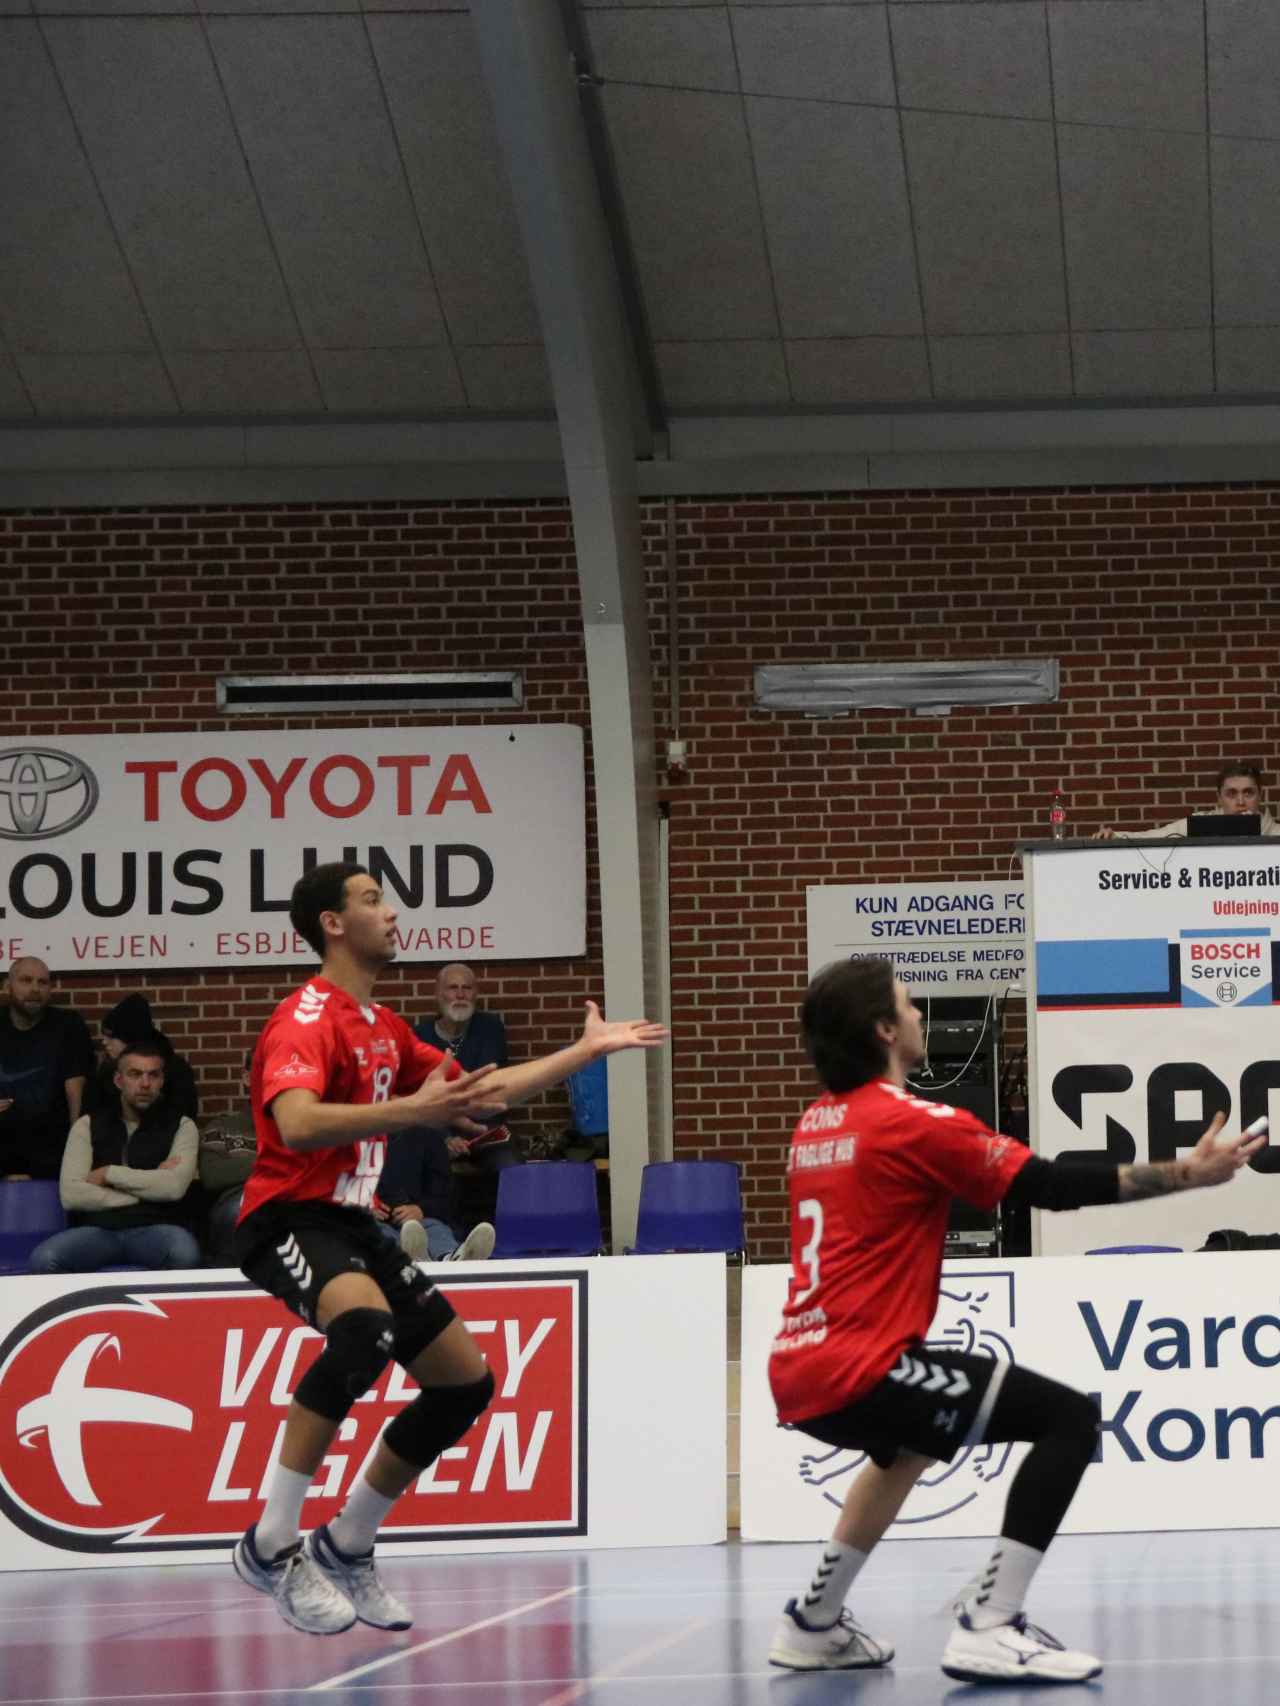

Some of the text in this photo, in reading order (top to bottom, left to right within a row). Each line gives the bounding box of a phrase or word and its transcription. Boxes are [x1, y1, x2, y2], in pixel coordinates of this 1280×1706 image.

[125, 754, 493, 822] TOYOTA
[0, 844, 494, 919] OUIS LND
[1098, 868, 1172, 890] Service
[1178, 868, 1192, 888] &
[855, 896, 898, 914] KUN
[907, 894, 994, 913] ADGANG
[1213, 900, 1279, 916] Udlejning
[871, 917, 1026, 937] STÆVNELEDER
[0, 926, 495, 960] E VEJEN ESBJE VARDE
[1190, 943, 1261, 961] BOSCH
[973, 949, 1024, 962] MEDFØ
[957, 969, 984, 981] FRA
[1191, 963, 1261, 980] Service
[798, 1198, 823, 1307] 3
